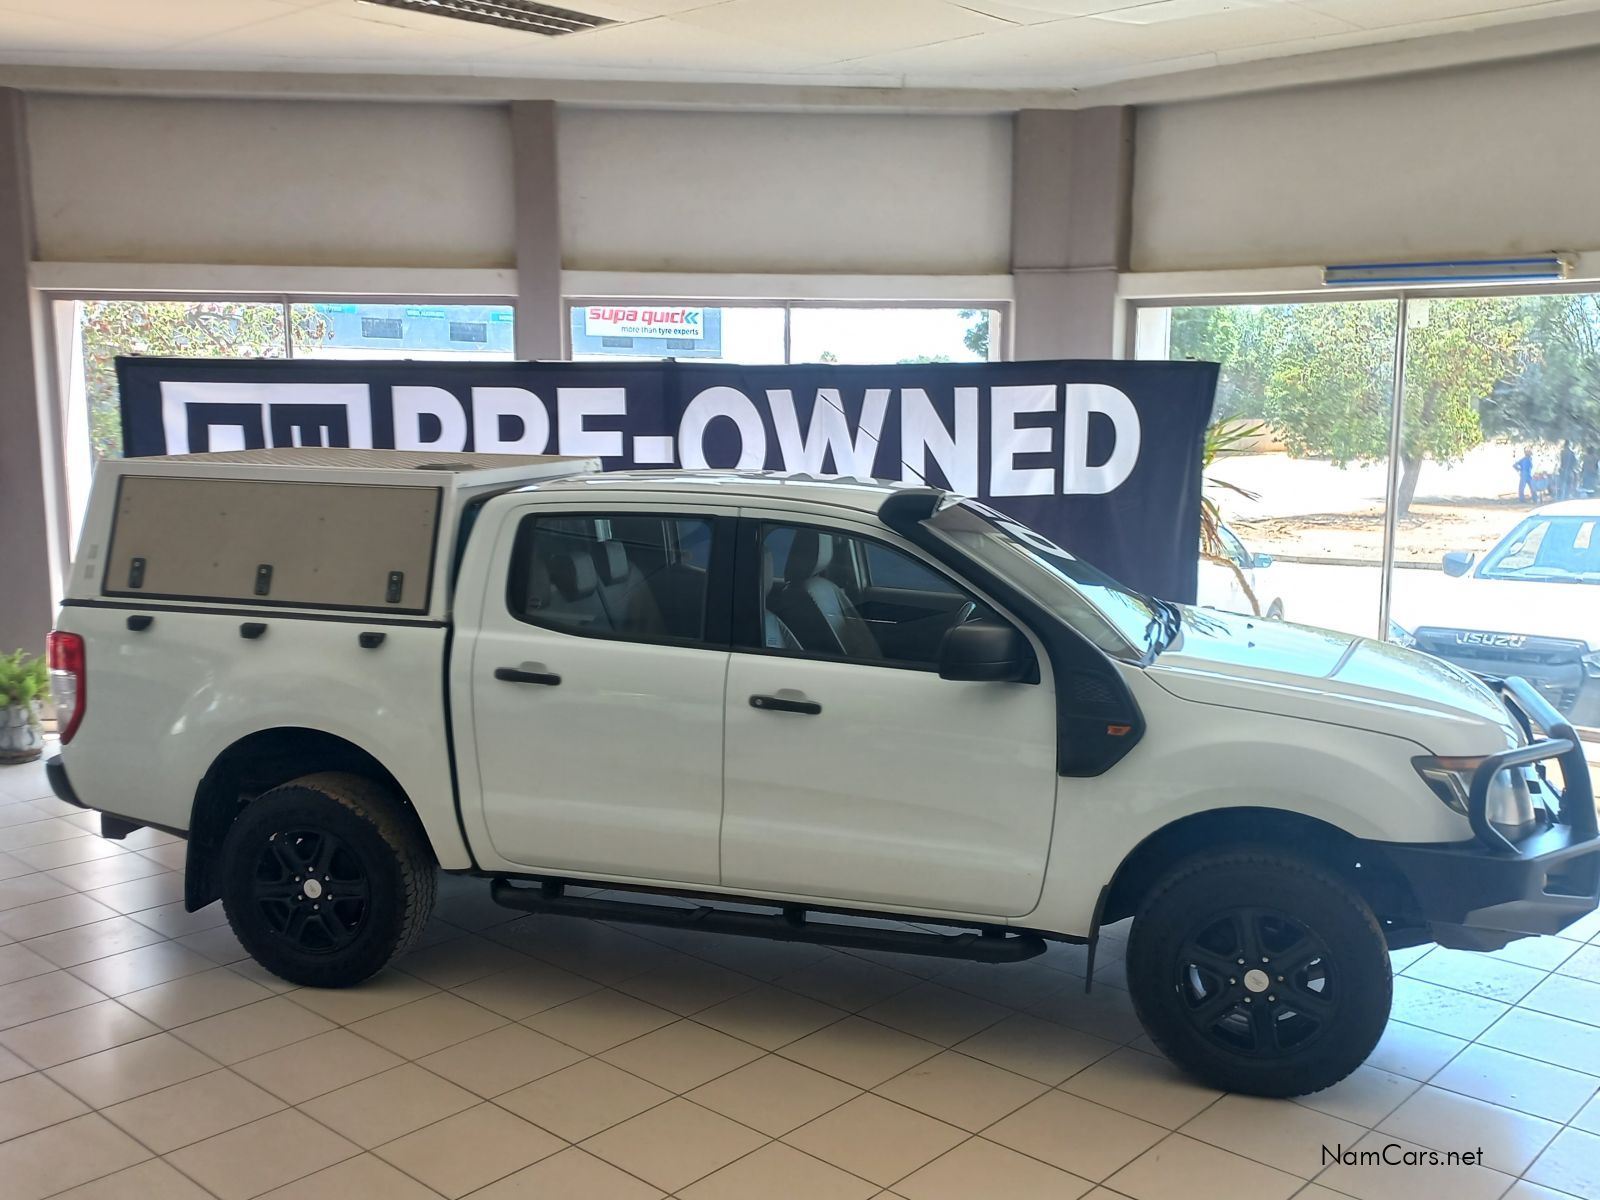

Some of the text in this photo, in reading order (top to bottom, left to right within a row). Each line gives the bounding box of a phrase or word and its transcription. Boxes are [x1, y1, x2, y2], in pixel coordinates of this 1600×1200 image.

[589, 308, 638, 324] supa
[621, 325, 699, 336] more than tyre experts
[391, 383, 1141, 497] PRE-OWNED
[1456, 632, 1526, 647] ISUZU
